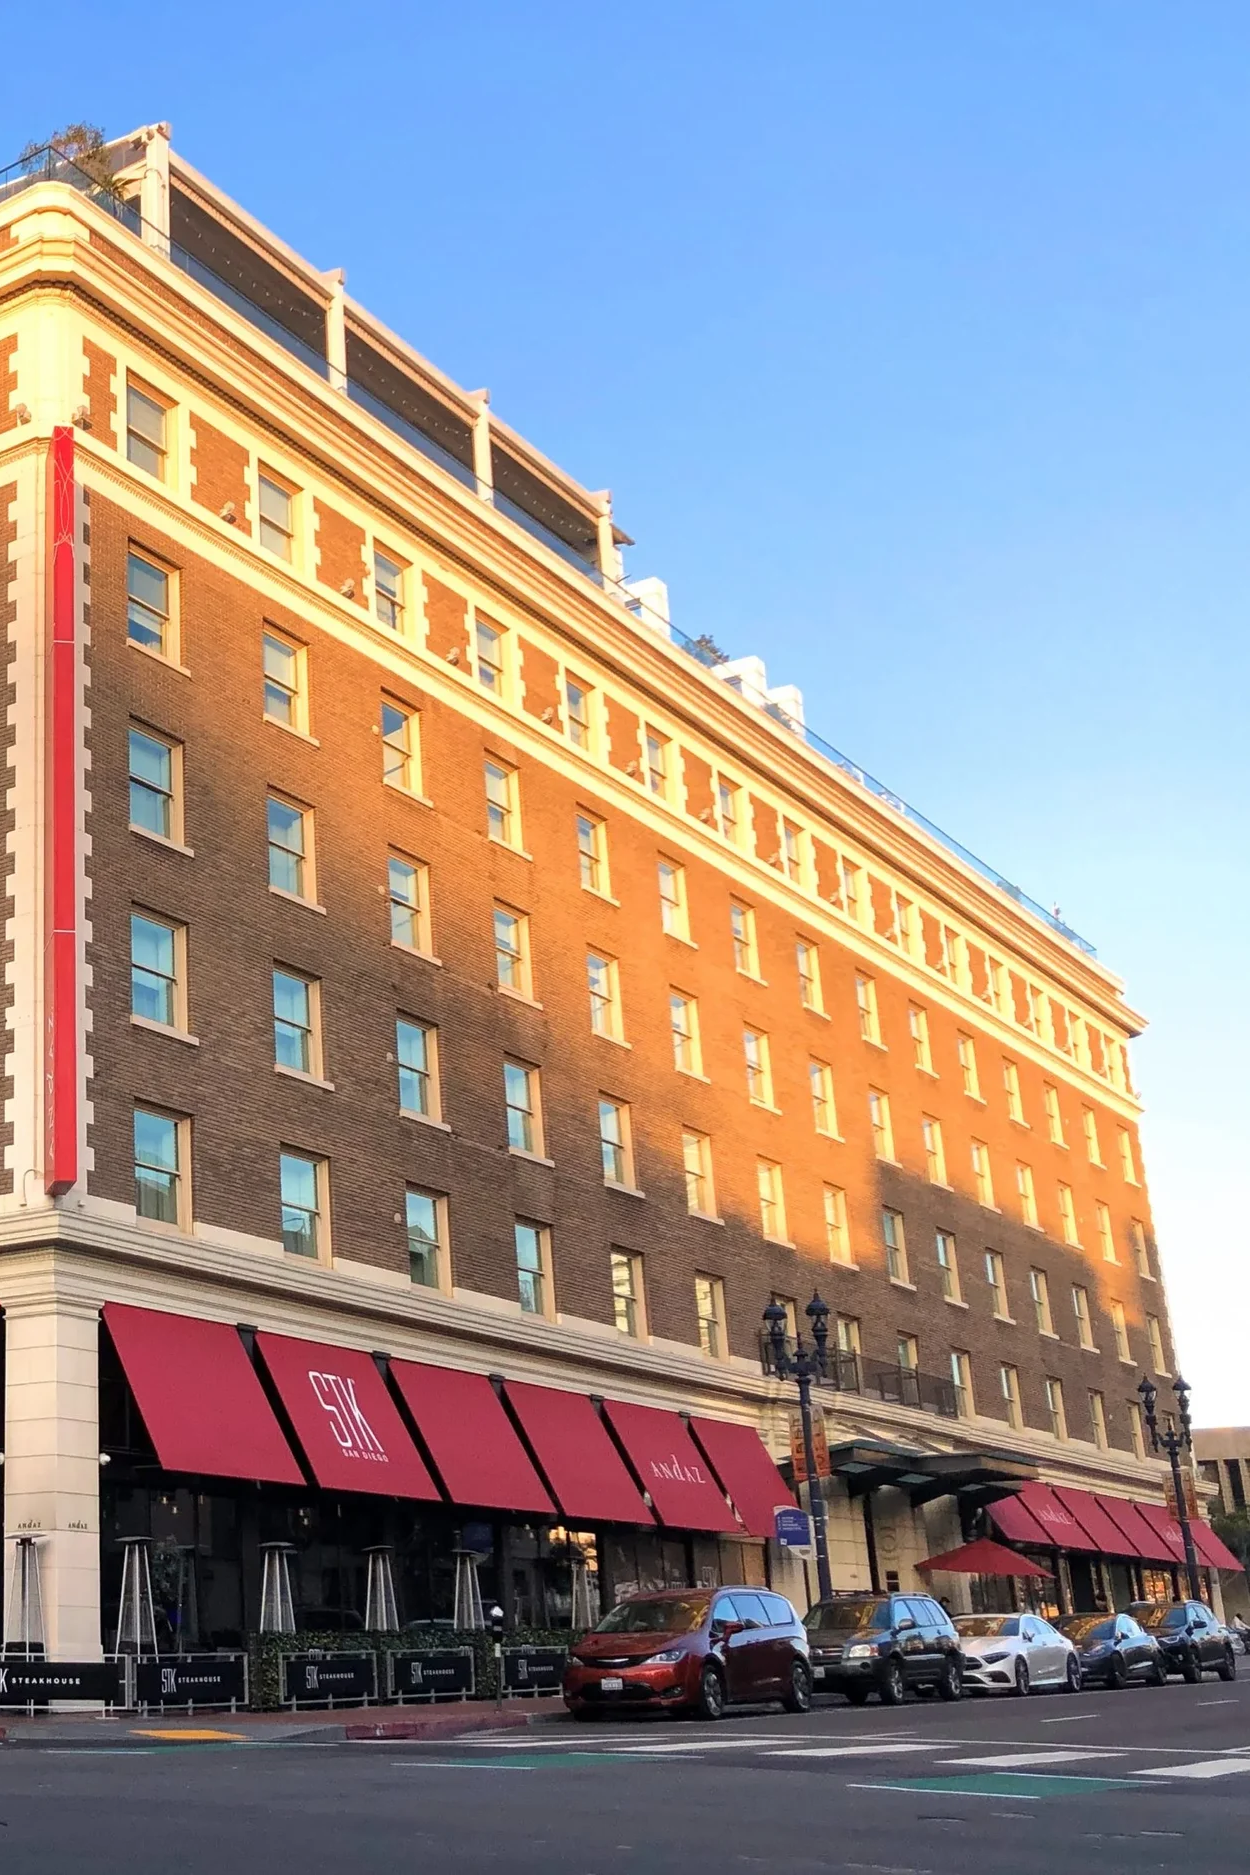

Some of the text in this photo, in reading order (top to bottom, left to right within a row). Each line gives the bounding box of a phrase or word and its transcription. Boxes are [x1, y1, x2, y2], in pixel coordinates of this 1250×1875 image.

[308, 1371, 384, 1453] STK
[342, 1448, 389, 1463] SAN DIEGO
[11, 1677, 81, 1685] STEAKHOUSE
[161, 1668, 221, 1693] STK STEAKHOUSE
[305, 1666, 319, 1689] STK
[423, 1668, 455, 1676] STEAKHOUSE
